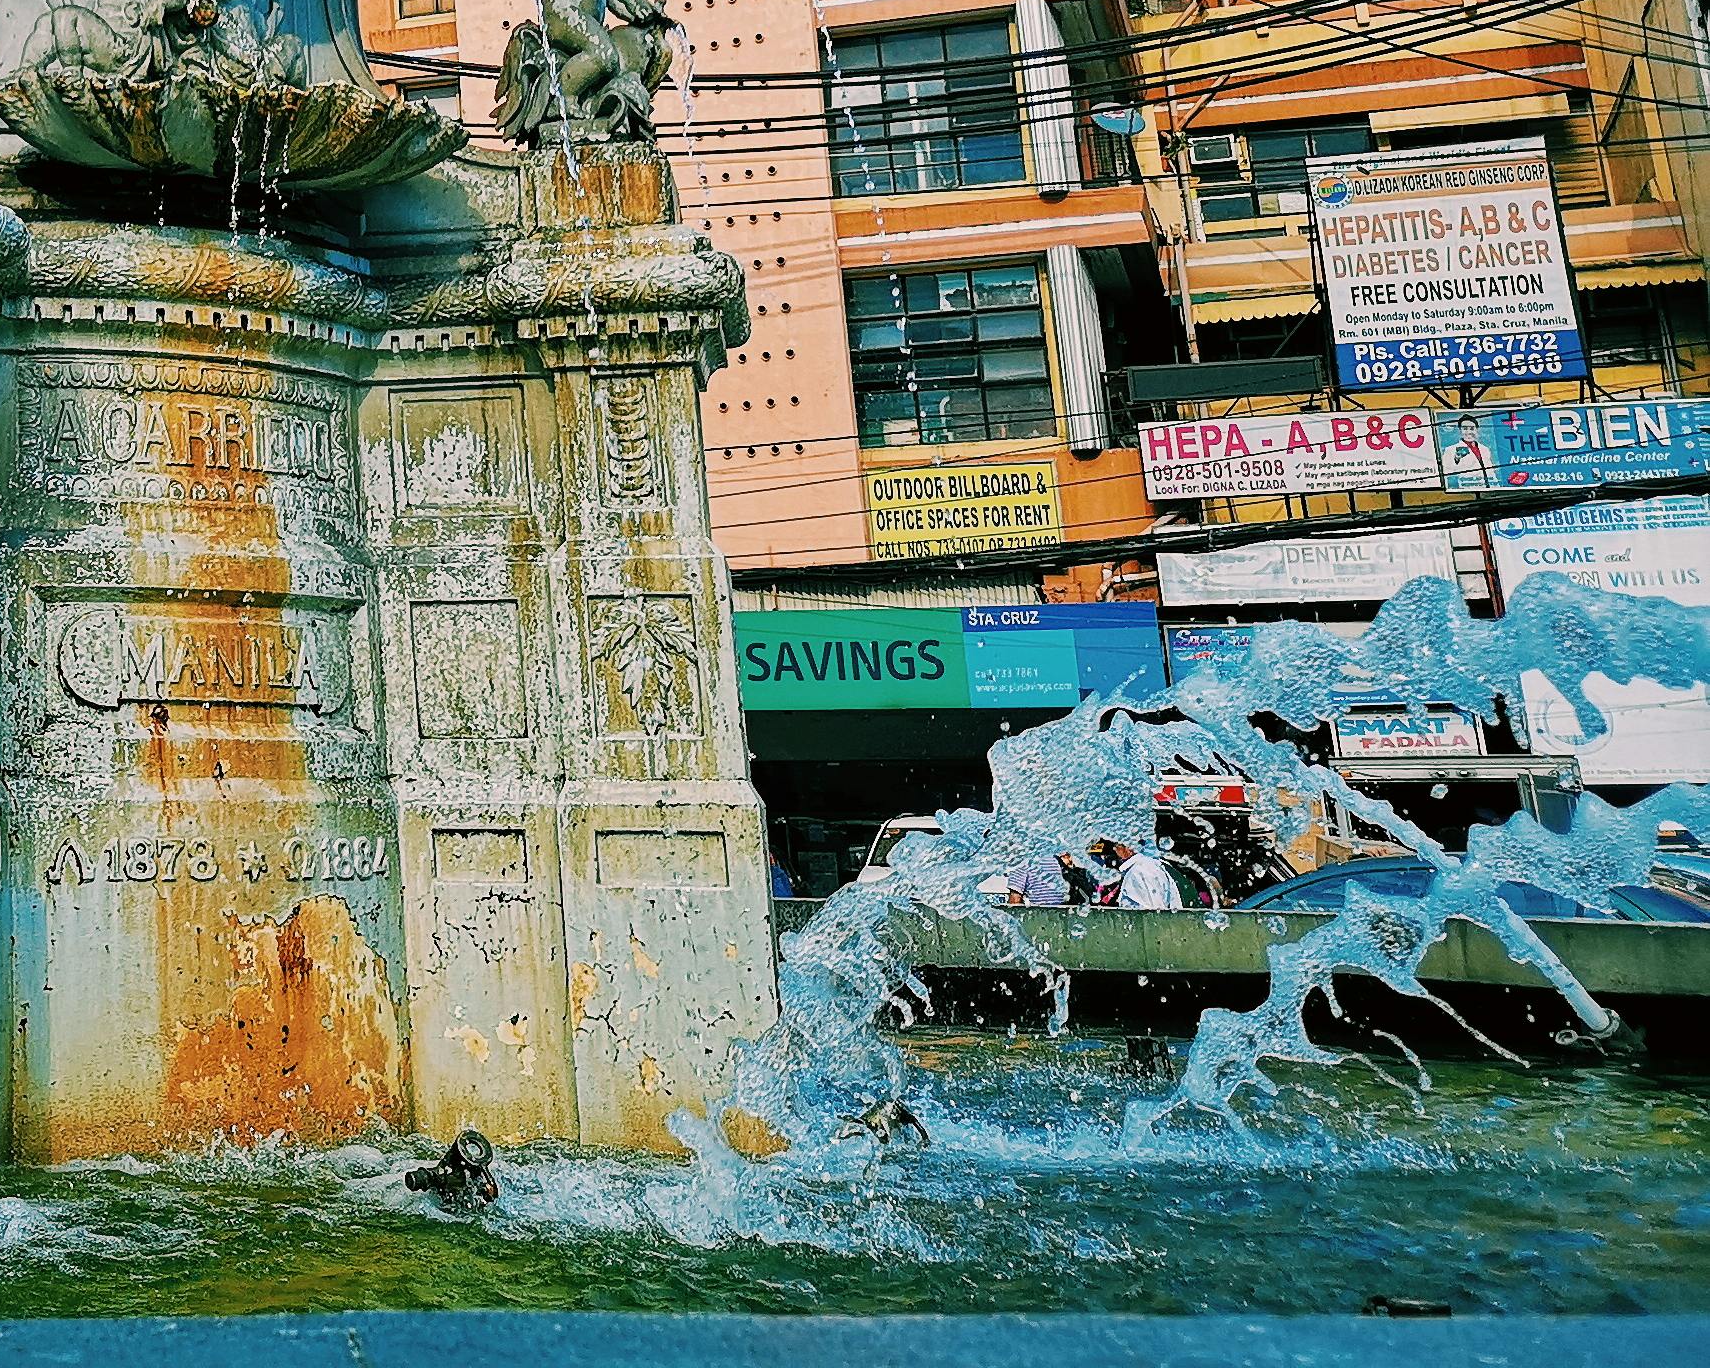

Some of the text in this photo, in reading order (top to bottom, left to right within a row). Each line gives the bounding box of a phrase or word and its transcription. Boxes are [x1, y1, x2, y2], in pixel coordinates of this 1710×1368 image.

[1400, 173, 1443, 193] KOREAN
[1445, 171, 1466, 188] RED
[1468, 166, 1515, 186] GINSENG
[1517, 164, 1548, 182] CORP.
[1507, 201, 1528, 233] &
[1531, 200, 1551, 232] C
[1331, 247, 1440, 279] DIABETES
[1458, 239, 1553, 270] CANCER
[1350, 273, 1544, 308] FREE CONSULTATION
[1338, 329, 1359, 339] Rm.
[1478, 320, 1500, 330] Sta.
[1532, 316, 1569, 327] Manila
[1345, 313, 1370, 325] Open
[1372, 312, 1409, 323] Monday
[1411, 311, 1421, 320] to
[1423, 305, 1466, 319] Saturday
[1467, 304, 1504, 316] 9:00am
[1505, 303, 1516, 314] to
[1353, 332, 1559, 361] Pls. Call: 736-7732
[1147, 422, 1251, 461] HEPA
[1504, 433, 1549, 452] THE
[1549, 405, 1673, 451] BIEN
[1152, 459, 1285, 482] 0928-501-9508
[1561, 452, 1621, 464] Medicine
[1624, 451, 1671, 463] Center
[873, 471, 1047, 501] OUTDOOR BILLBOARD &
[1155, 484, 1179, 496] Look
[1181, 482, 1201, 494] For:
[1202, 481, 1236, 493] DIGNA
[1249, 479, 1288, 491] LIZADA
[876, 504, 1051, 531] OFFICE SPACES FOR RENT
[1533, 510, 1575, 526] CEBU
[1578, 508, 1624, 525] GEMS
[876, 540, 904, 559] CALL
[1285, 544, 1371, 564] DENTAL
[1522, 546, 1632, 565] COME and
[1672, 566, 1701, 585] US
[968, 610, 1040, 626] STA. CRUZ
[120, 631, 320, 689] MANILA
[744, 638, 946, 683] SAVINGS
[103, 836, 220, 883] 1878
